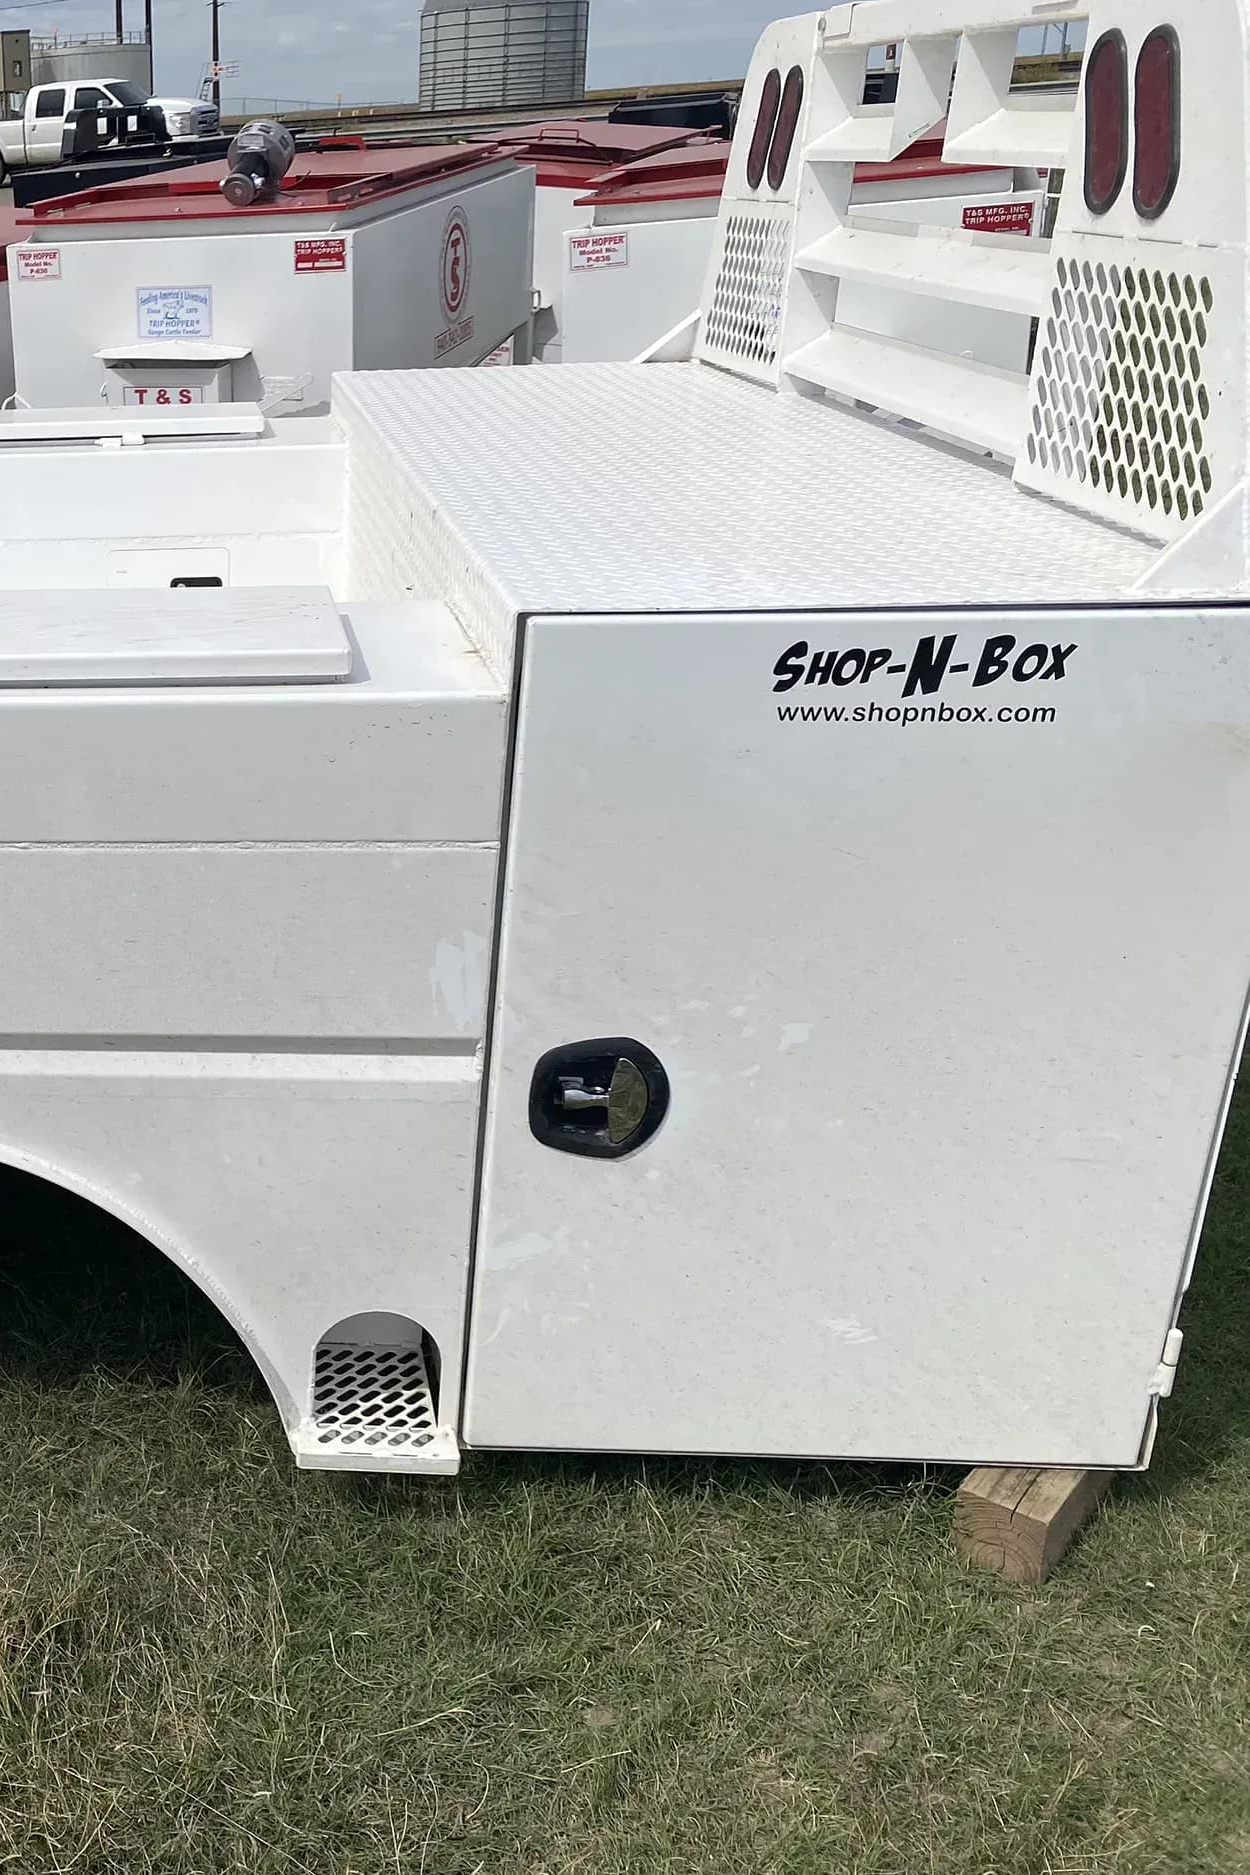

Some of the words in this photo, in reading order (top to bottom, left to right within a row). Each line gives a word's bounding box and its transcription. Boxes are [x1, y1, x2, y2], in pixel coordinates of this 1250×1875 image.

[985, 207, 1008, 215] MFG.
[1010, 205, 1029, 213] INC.
[572, 239, 590, 248] TRIP
[579, 248, 603, 256] Model
[150, 320, 165, 328] TRIP
[134, 389, 148, 404] T
[156, 389, 171, 404] &
[179, 389, 192, 404] S
[777, 702, 1056, 727] www.shopnbox.com
